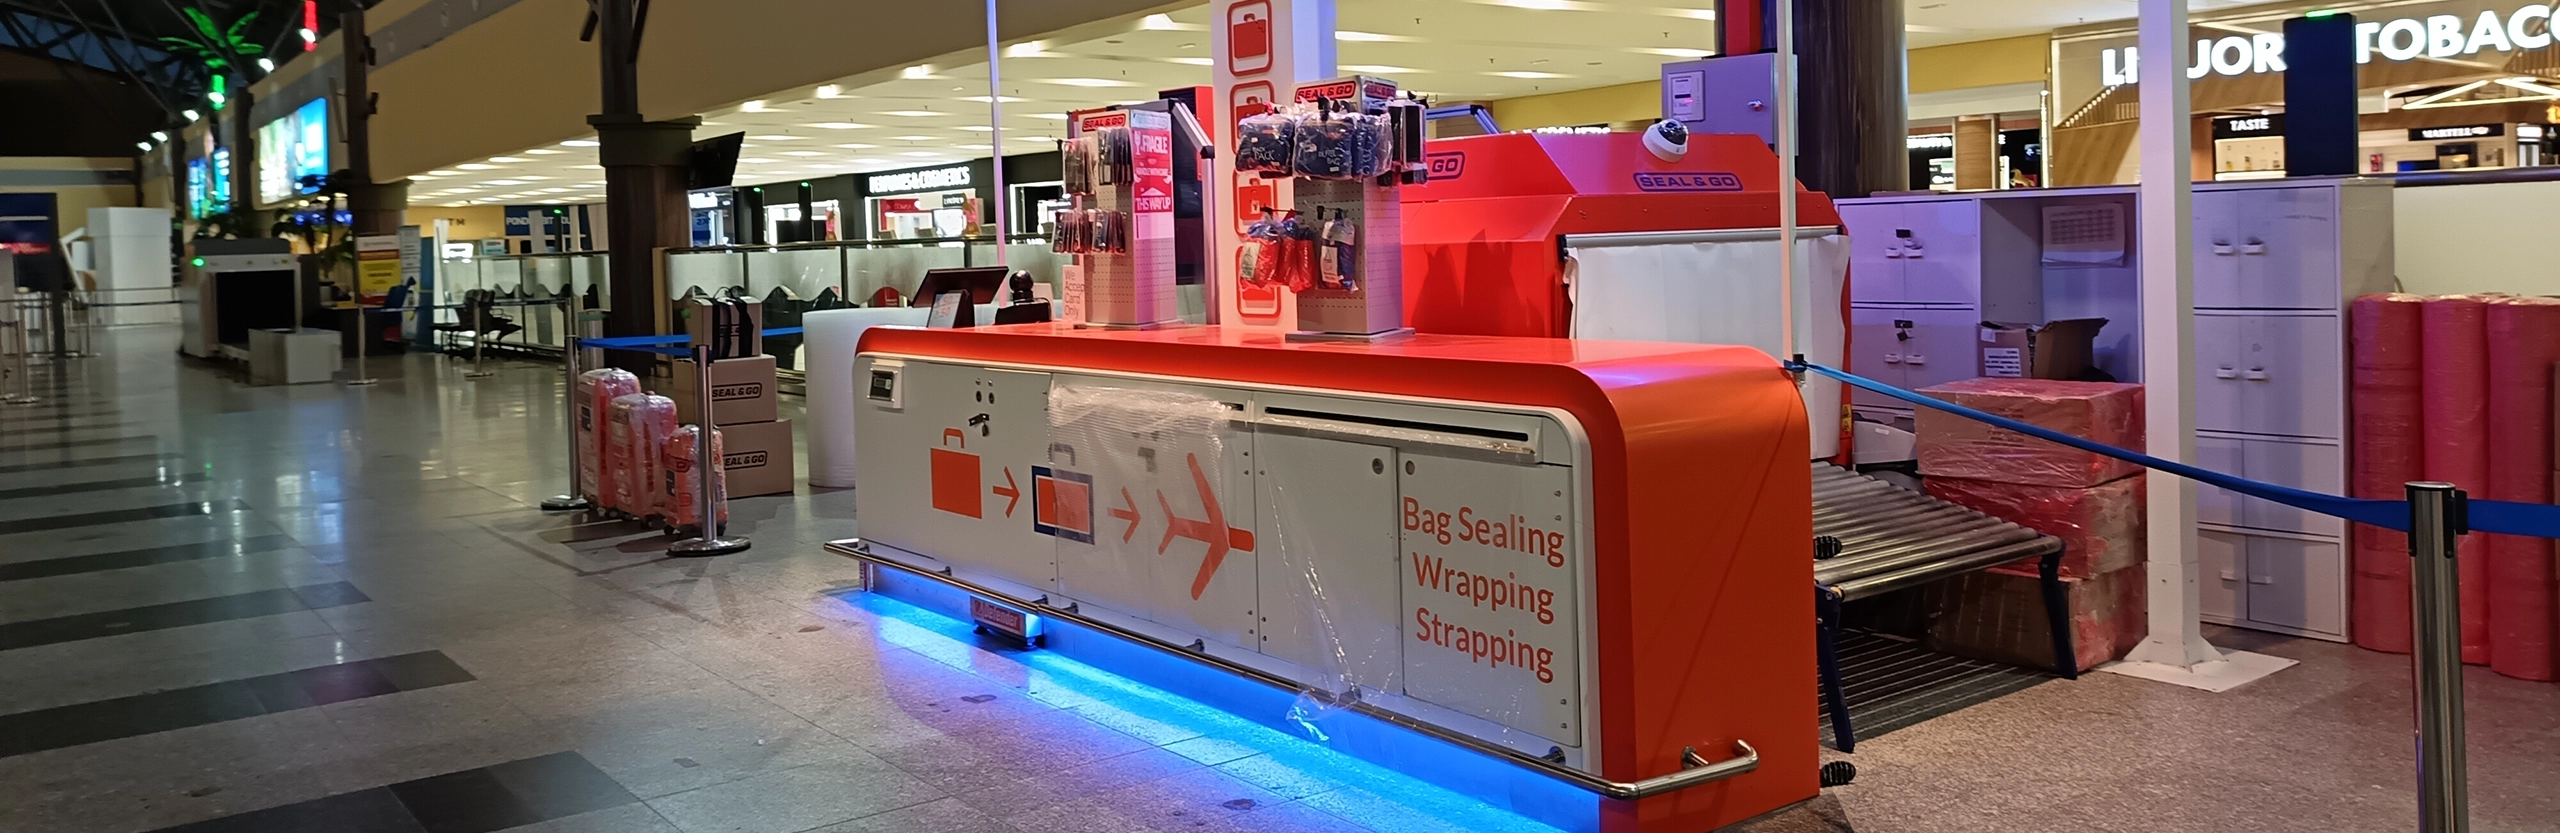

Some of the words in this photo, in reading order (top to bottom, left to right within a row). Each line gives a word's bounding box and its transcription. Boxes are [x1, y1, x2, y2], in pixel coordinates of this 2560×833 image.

[2356, 5, 2560, 64] TOBAC
[1335, 84, 1353, 95] GO
[2229, 118, 2269, 131] TASTE
[2422, 127, 2473, 139] MARTELL
[1142, 135, 1168, 154] FRAGILE
[1254, 151, 1275, 161] PACK
[1432, 158, 1458, 172] GO
[1640, 177, 1692, 187] SEAL
[1693, 177, 1707, 186] &
[1708, 177, 1735, 186] GO
[1162, 197, 1171, 210] UP
[1065, 281, 1085, 292] Accep
[711, 388, 736, 398] SEAL
[738, 387, 745, 396] &
[745, 386, 760, 395] GO
[724, 457, 743, 466] EAL
[743, 456, 750, 464] &
[751, 454, 765, 463] GO
[1403, 496, 1452, 545] Bag
[1458, 506, 1565, 568] Sealing
[1412, 552, 1555, 624] Wrapping
[984, 602, 1018, 628] Defender
[1416, 607, 1554, 684] Strapping
